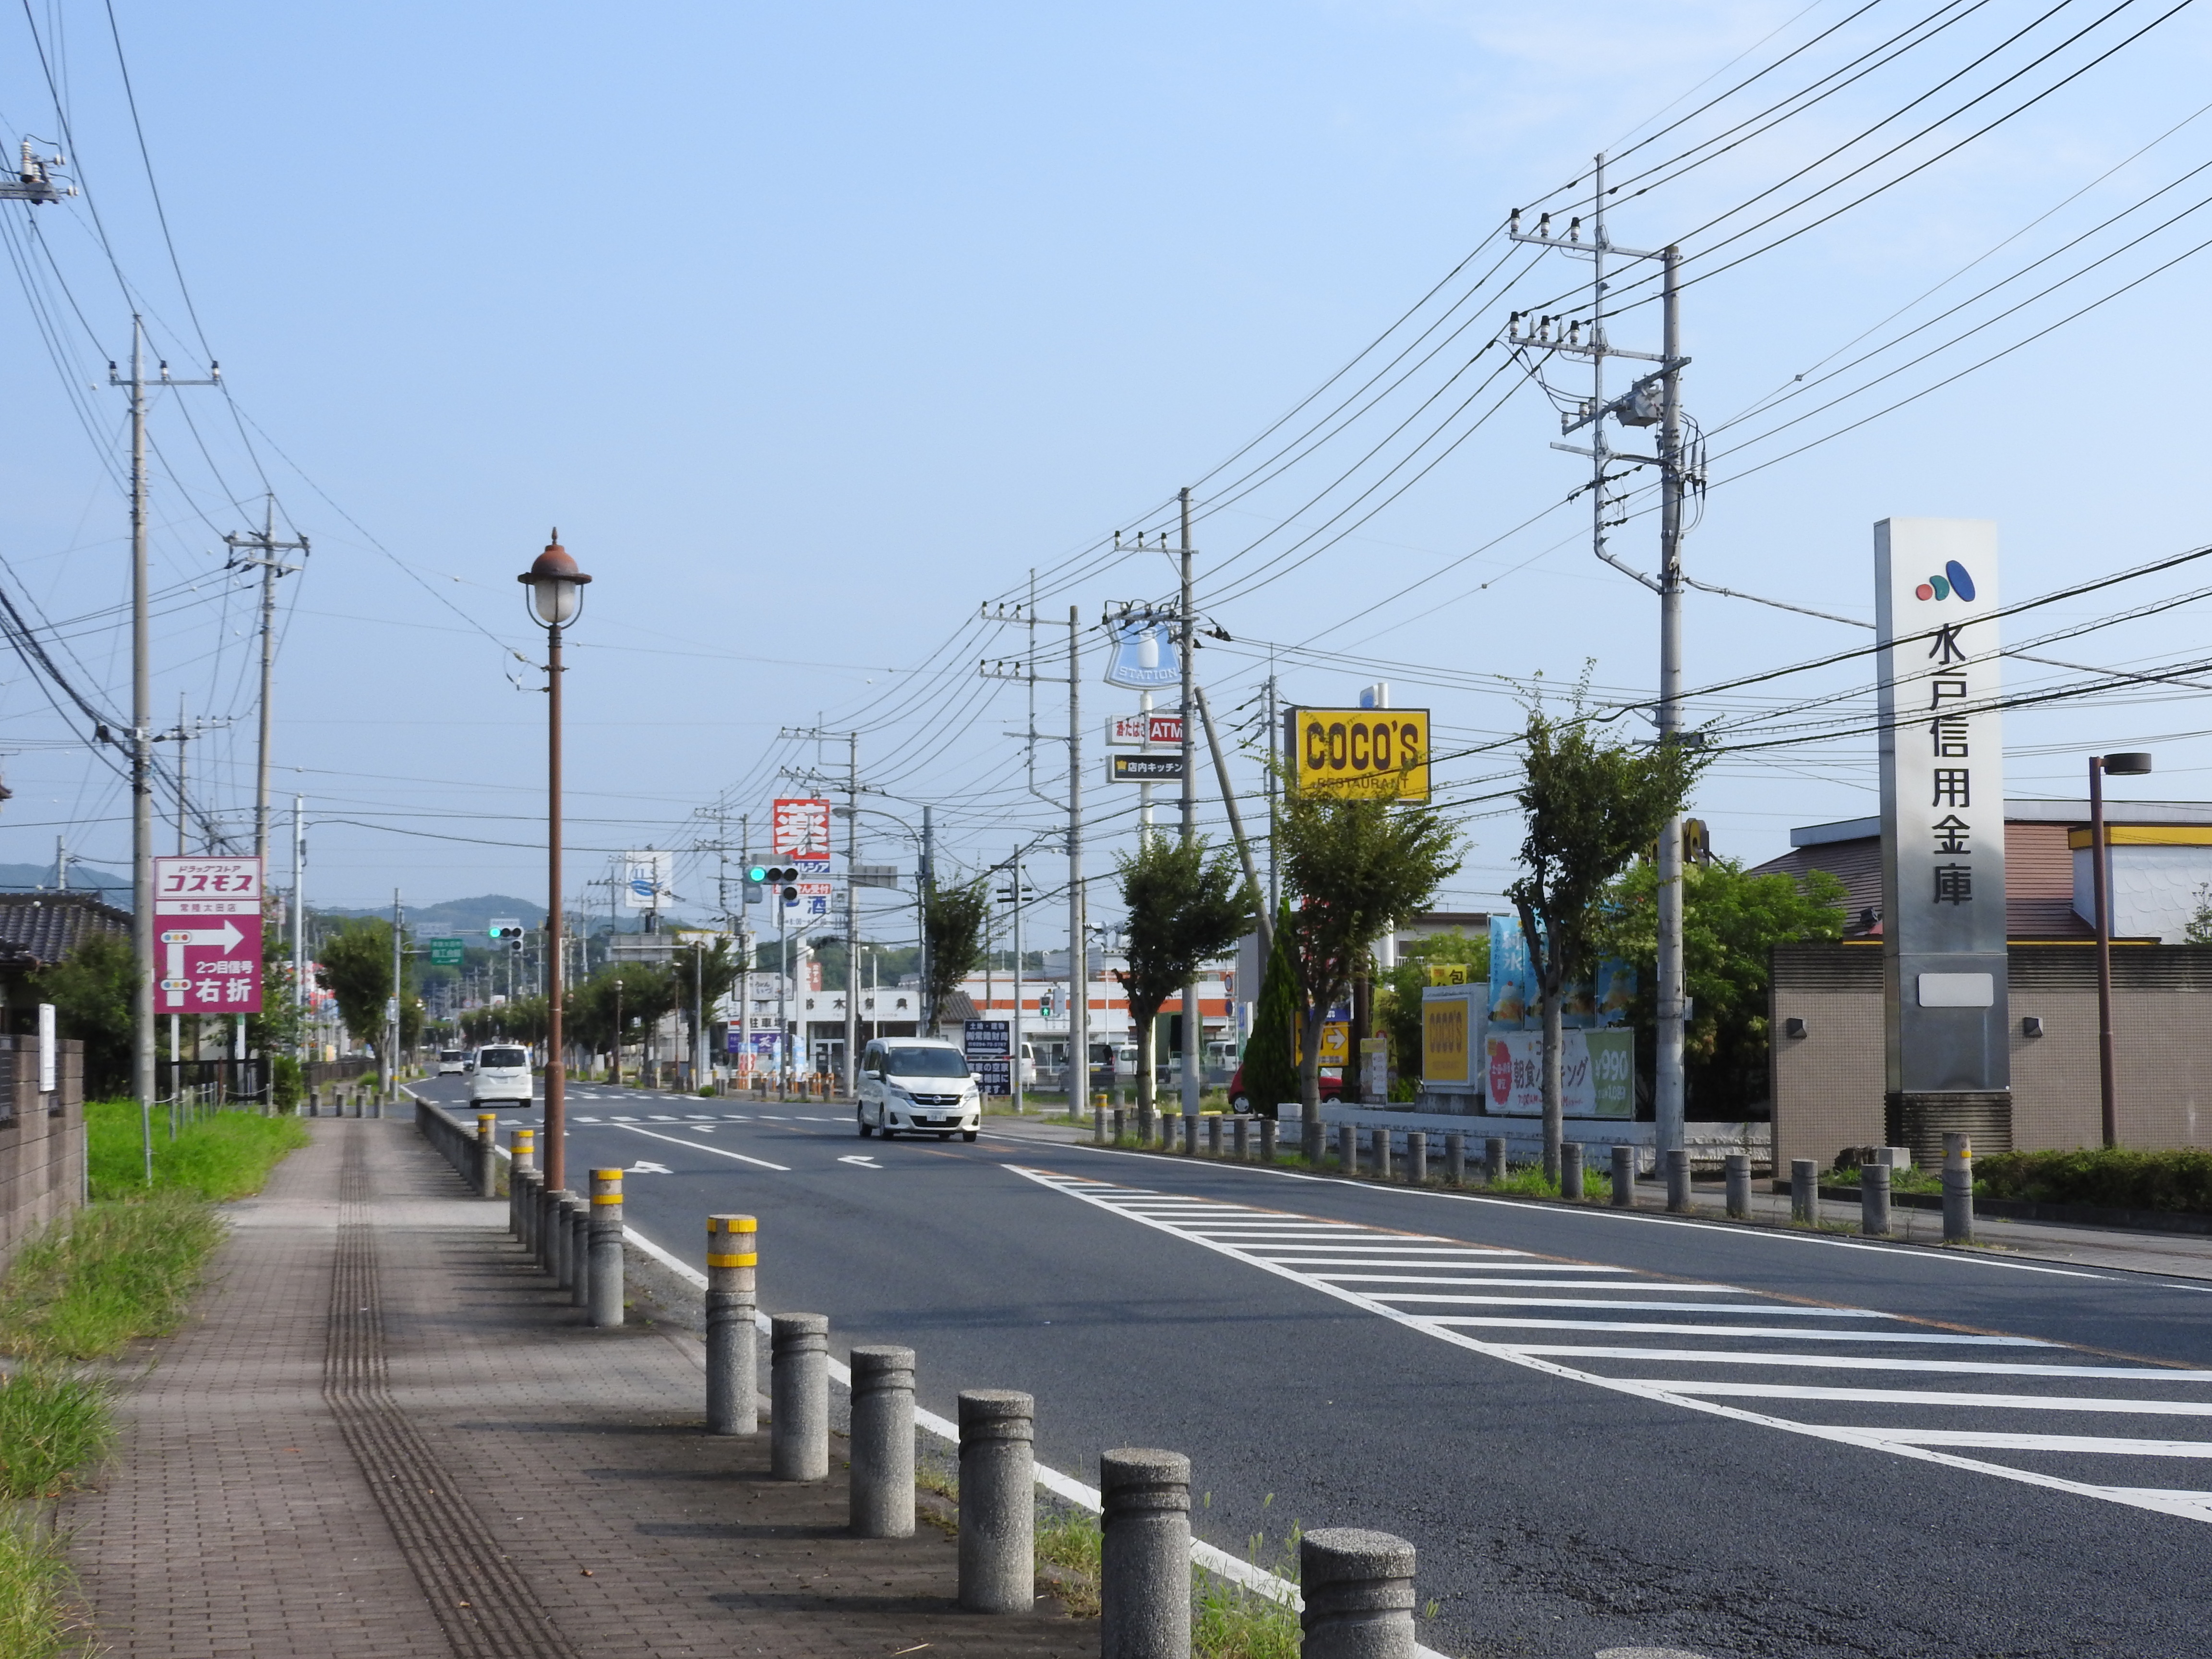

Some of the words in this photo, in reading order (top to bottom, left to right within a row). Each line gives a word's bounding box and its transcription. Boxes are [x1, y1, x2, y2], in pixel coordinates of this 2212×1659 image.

[1119, 666, 1178, 680] STATION
[1151, 722, 1183, 738] ATM
[1307, 720, 1418, 770] COCO'S
[1128, 762, 1183, 772] 店内キッチン
[1929, 623, 1973, 906] 水戸信用金庫
[776, 803, 828, 855] 薬
[164, 875, 253, 892] コスモス
[180, 903, 237, 912] 常陸太田店
[196, 961, 253, 974] 2つ目信号
[195, 978, 252, 1003] 右折
